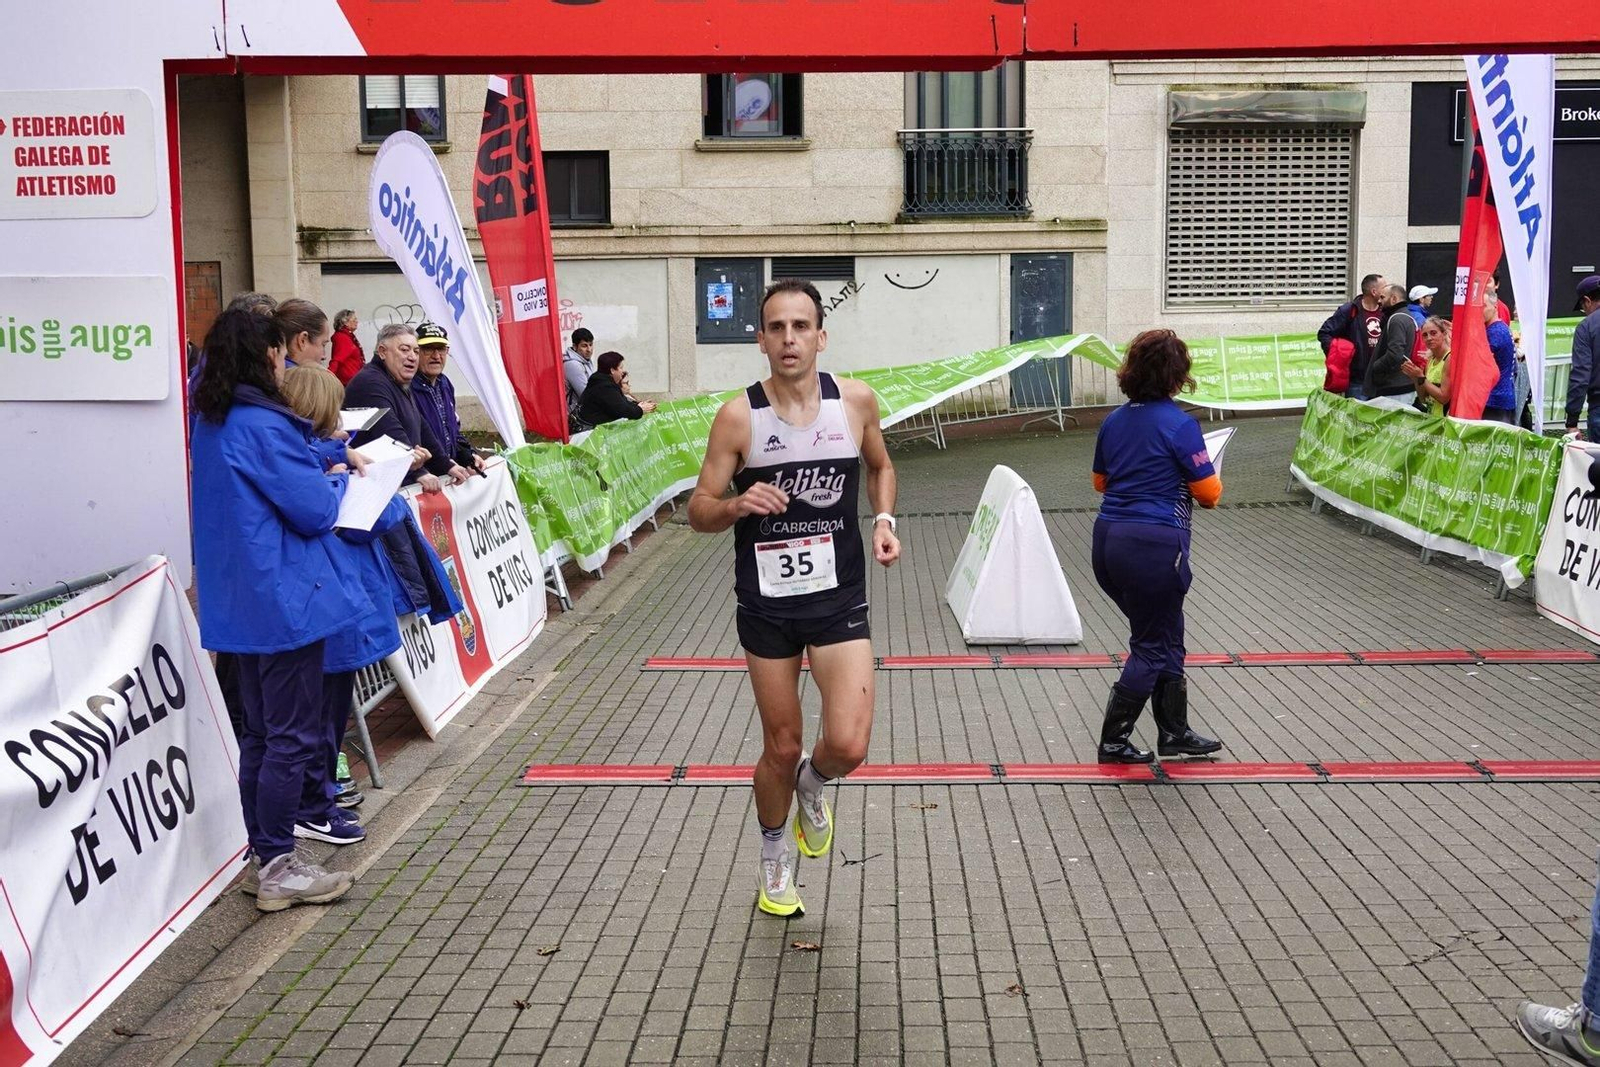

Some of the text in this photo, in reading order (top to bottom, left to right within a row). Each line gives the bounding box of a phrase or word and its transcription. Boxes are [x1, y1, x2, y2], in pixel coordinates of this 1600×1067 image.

[12, 111, 125, 137] FEDERACIÓN
[14, 145, 111, 167] GALEGA DE
[16, 174, 116, 197] ATLETISMO
[0, 316, 36, 354] is
[70, 324, 152, 361] auga
[769, 466, 846, 496] delikia
[811, 492, 832, 502] fresh
[1564, 486, 1600, 531] CON
[779, 551, 814, 579] 35
[1559, 538, 1589, 582] DE
[487, 549, 533, 609] DE VIG
[402, 617, 436, 680] VIGO
[65, 745, 196, 906] DE VIGO
